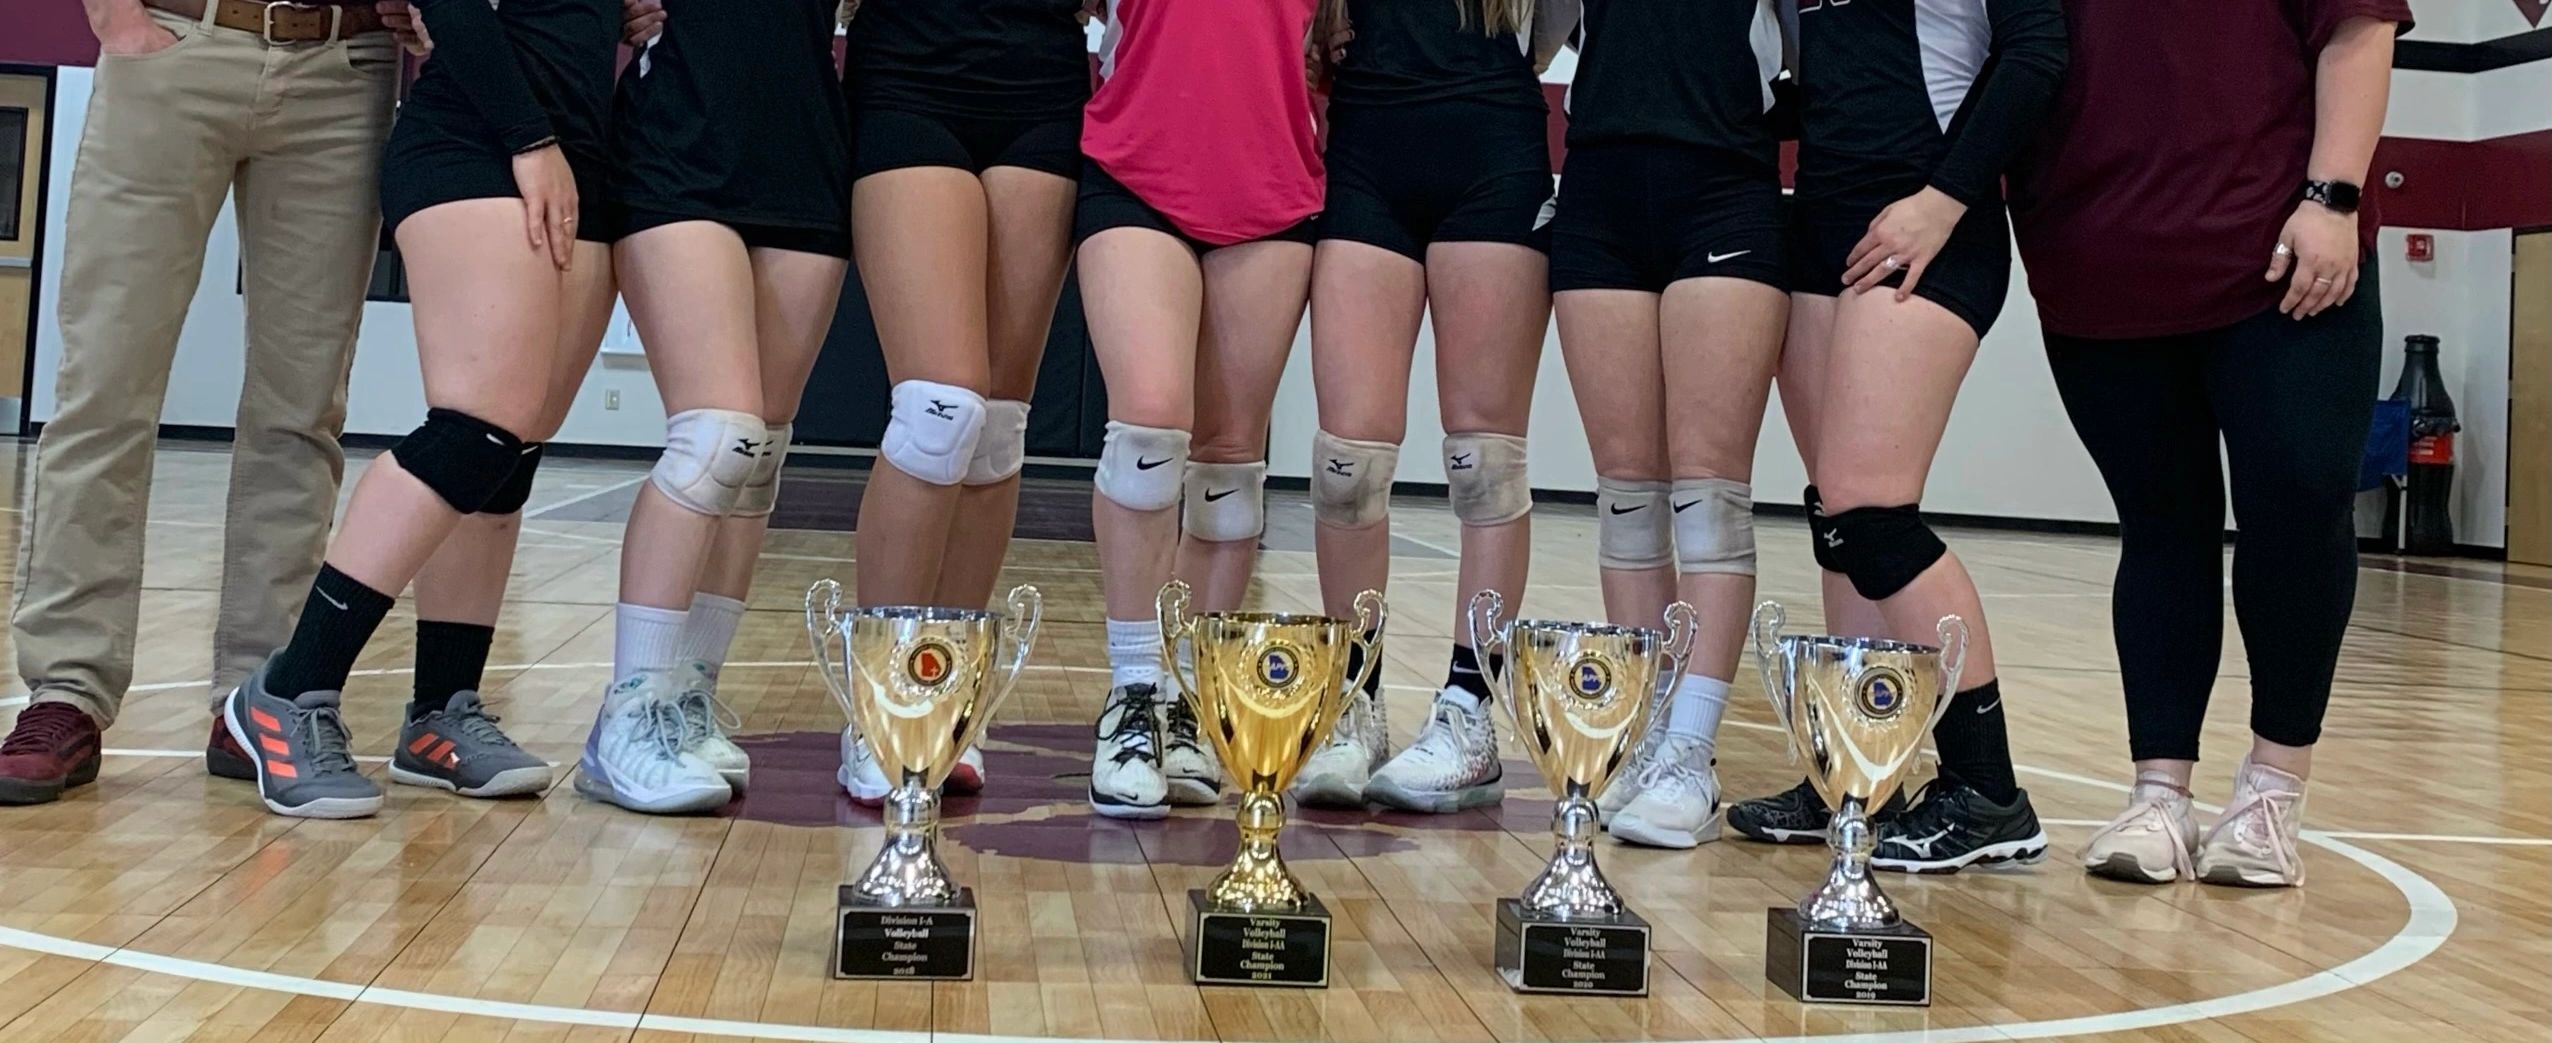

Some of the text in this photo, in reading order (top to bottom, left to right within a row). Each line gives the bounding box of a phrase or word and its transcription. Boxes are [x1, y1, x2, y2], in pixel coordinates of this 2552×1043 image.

[1250, 918, 1280, 928] Varsity
[884, 928, 930, 940] Volleyball
[1244, 928, 1286, 940] Volleyball
[1570, 927, 1601, 938] Varsity
[894, 941, 917, 950] State
[1564, 938, 1606, 949] Volleyball
[1852, 938, 1883, 948] Varsity
[882, 952, 928, 964] Champion
[1252, 952, 1274, 961] State
[1846, 948, 1888, 959] Volleyball
[1240, 960, 1284, 971] Champion
[1573, 961, 1594, 970] State
[1562, 969, 1606, 980] Champion
[1856, 972, 1878, 980] State
[1844, 980, 1888, 991] Champion
